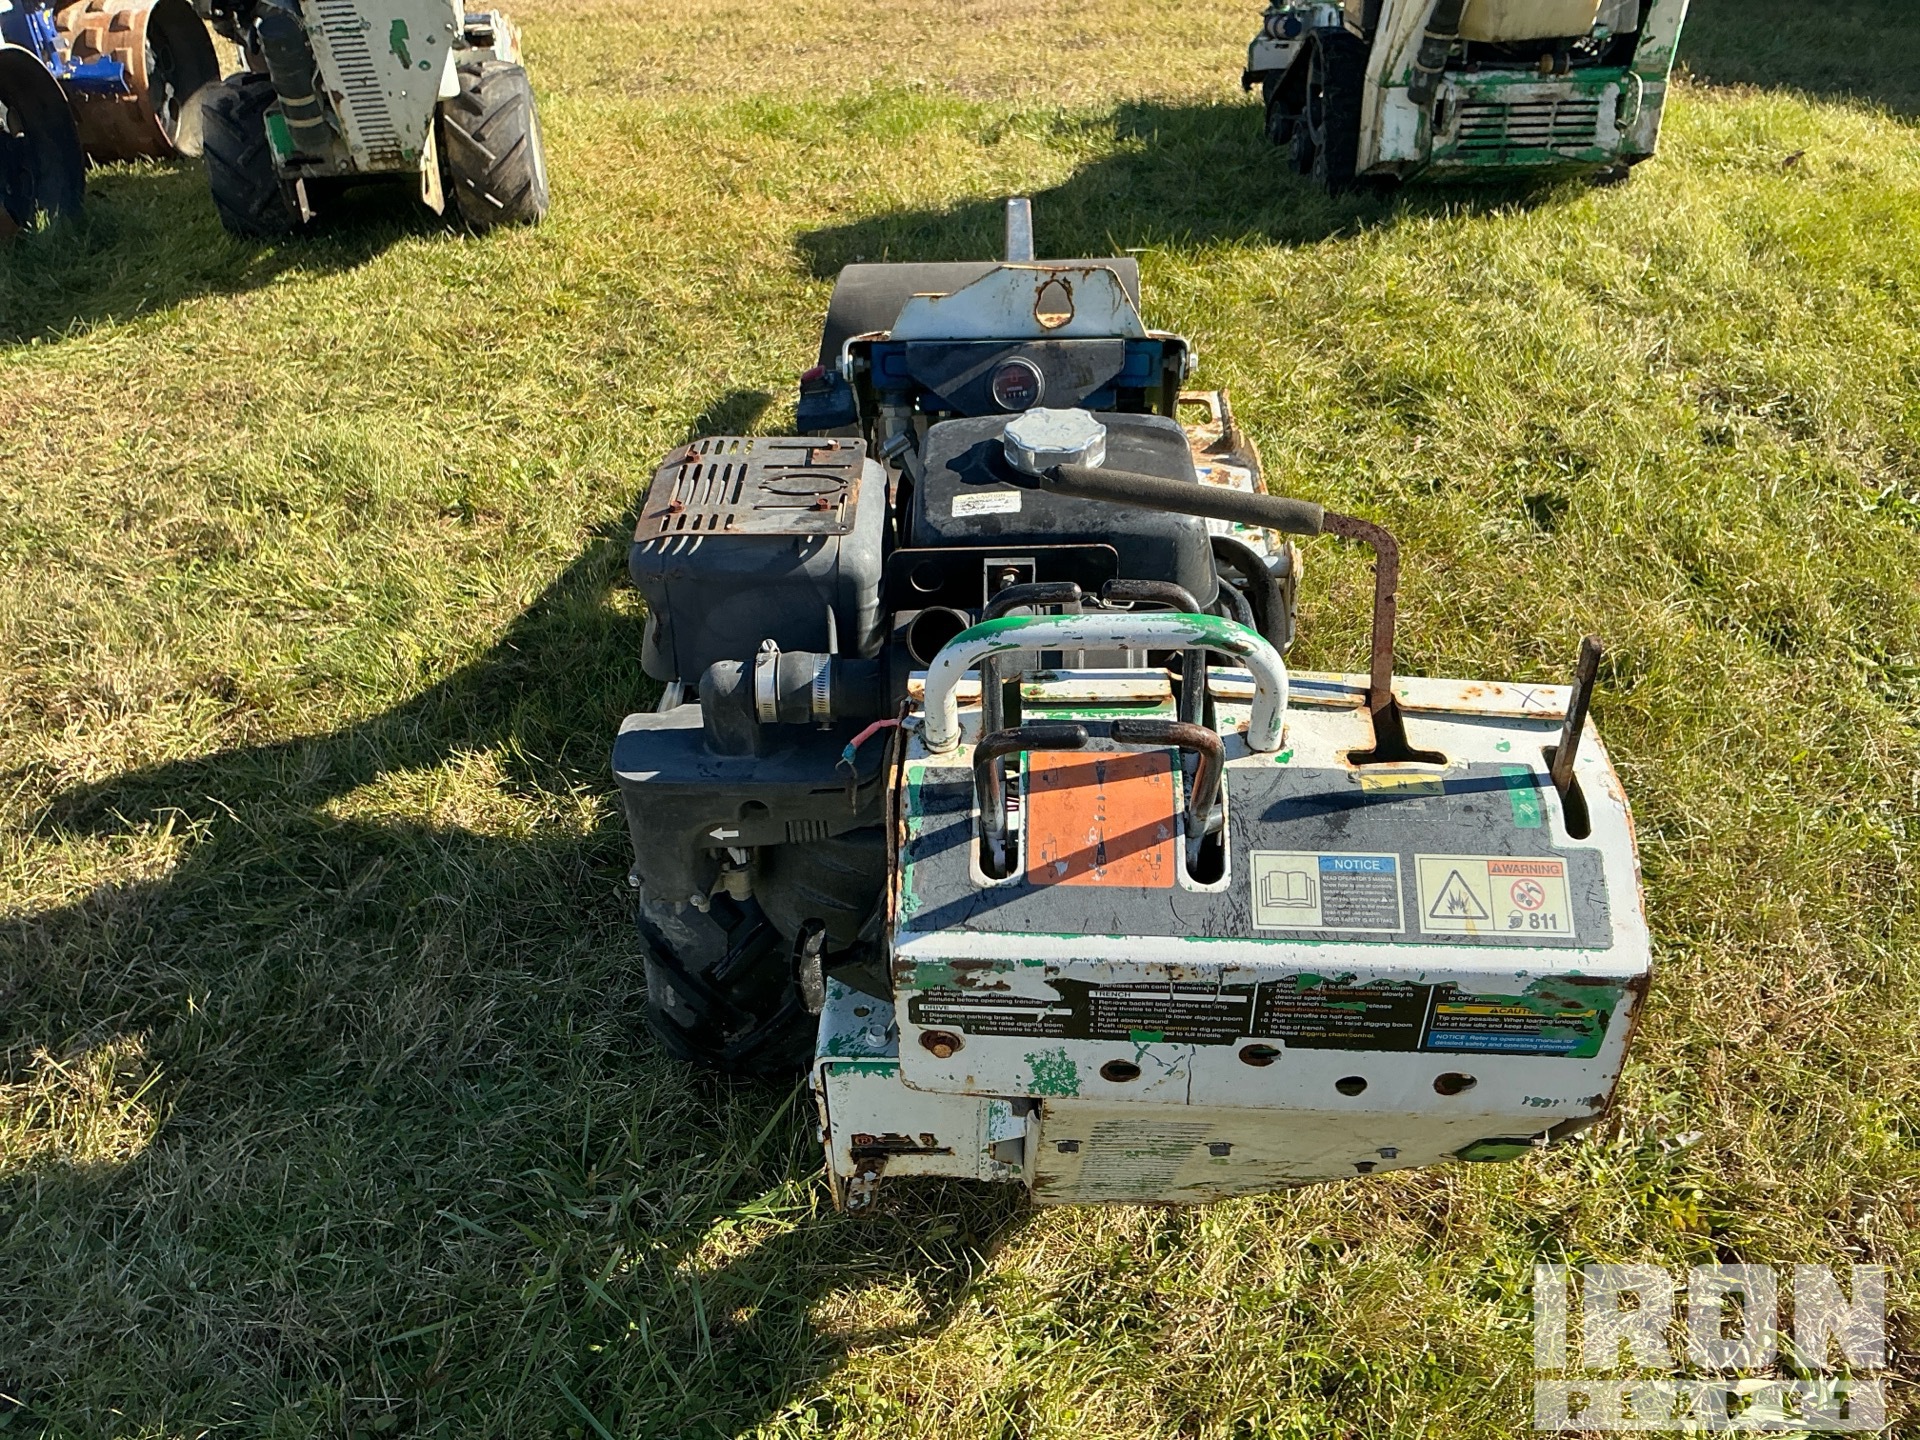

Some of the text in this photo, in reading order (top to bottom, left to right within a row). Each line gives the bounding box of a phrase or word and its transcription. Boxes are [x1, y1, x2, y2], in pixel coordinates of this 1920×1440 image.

[1334, 859, 1380, 870] NOTICE
[1502, 864, 1560, 874] WARNING
[1530, 913, 1557, 930] 811
